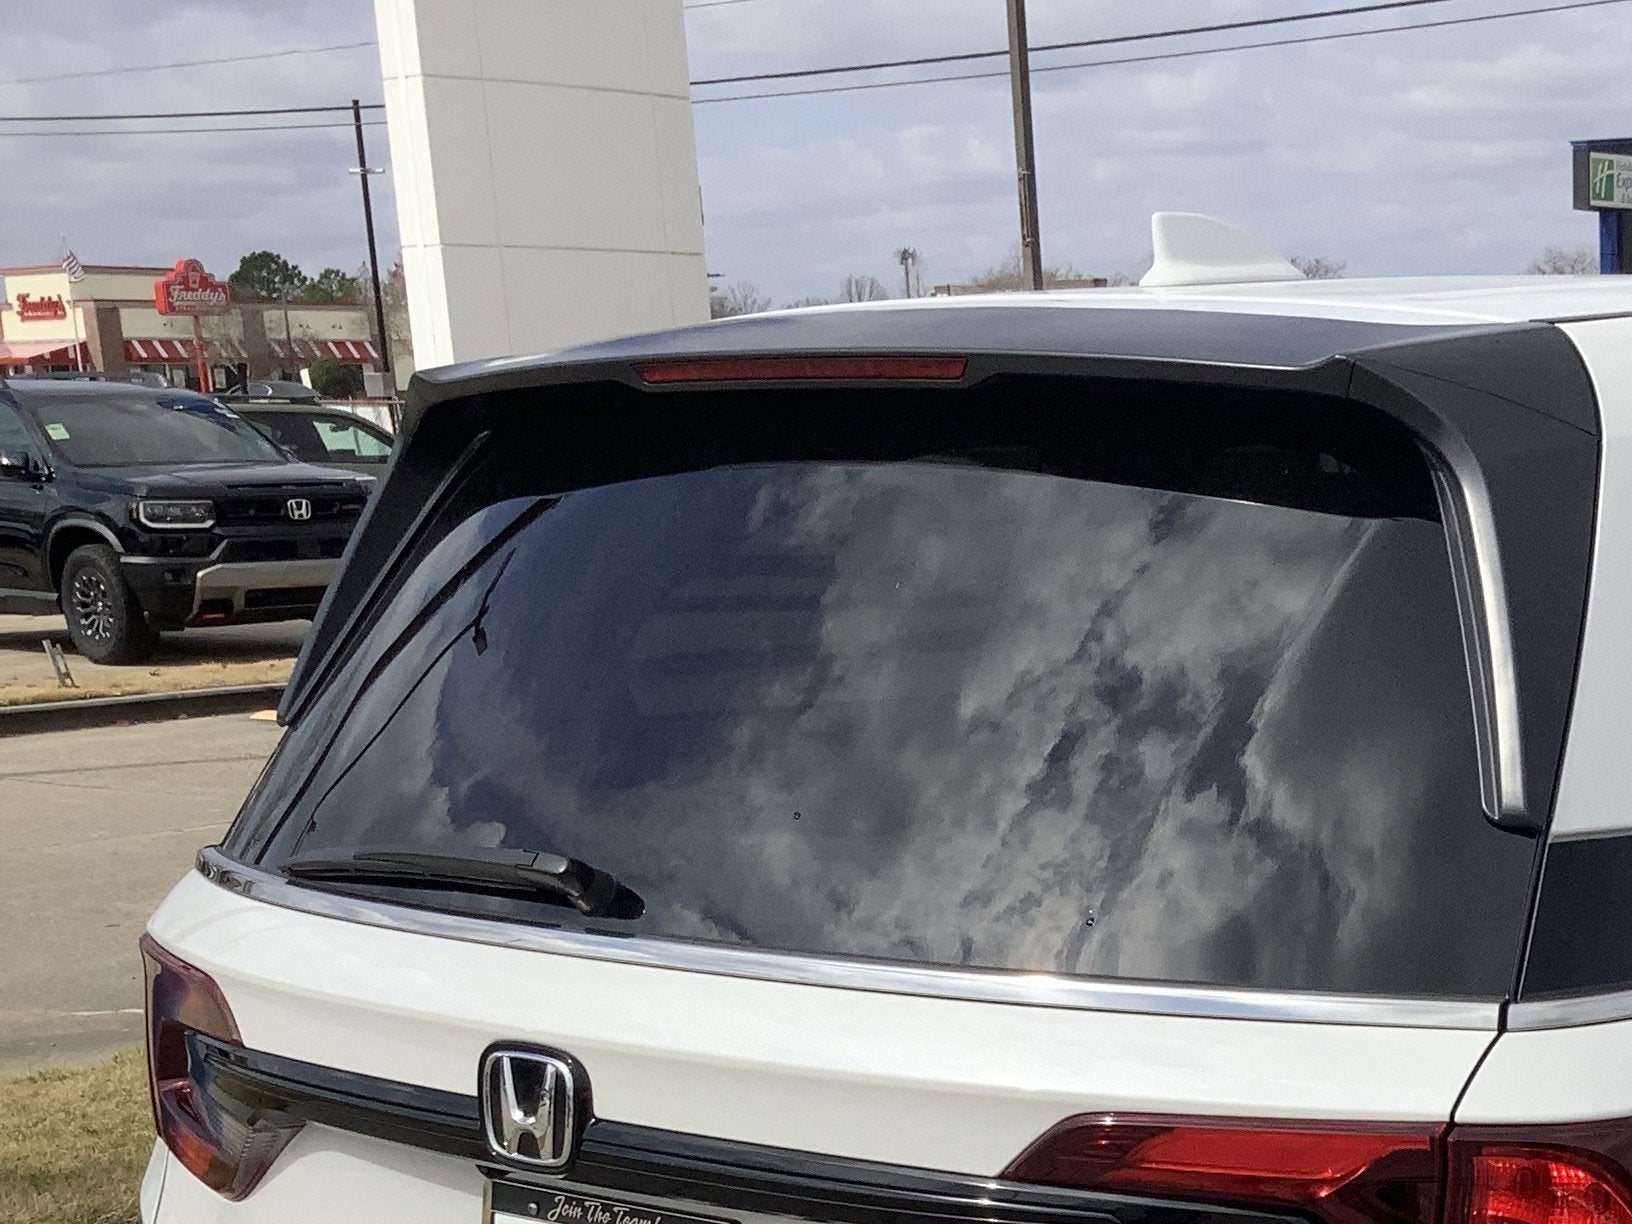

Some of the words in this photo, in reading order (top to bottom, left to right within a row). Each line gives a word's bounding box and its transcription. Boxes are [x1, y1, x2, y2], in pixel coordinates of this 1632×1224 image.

[168, 285, 227, 306] Freddy's
[547, 1196, 583, 1222] Join
[584, 1201, 611, 1224] The
